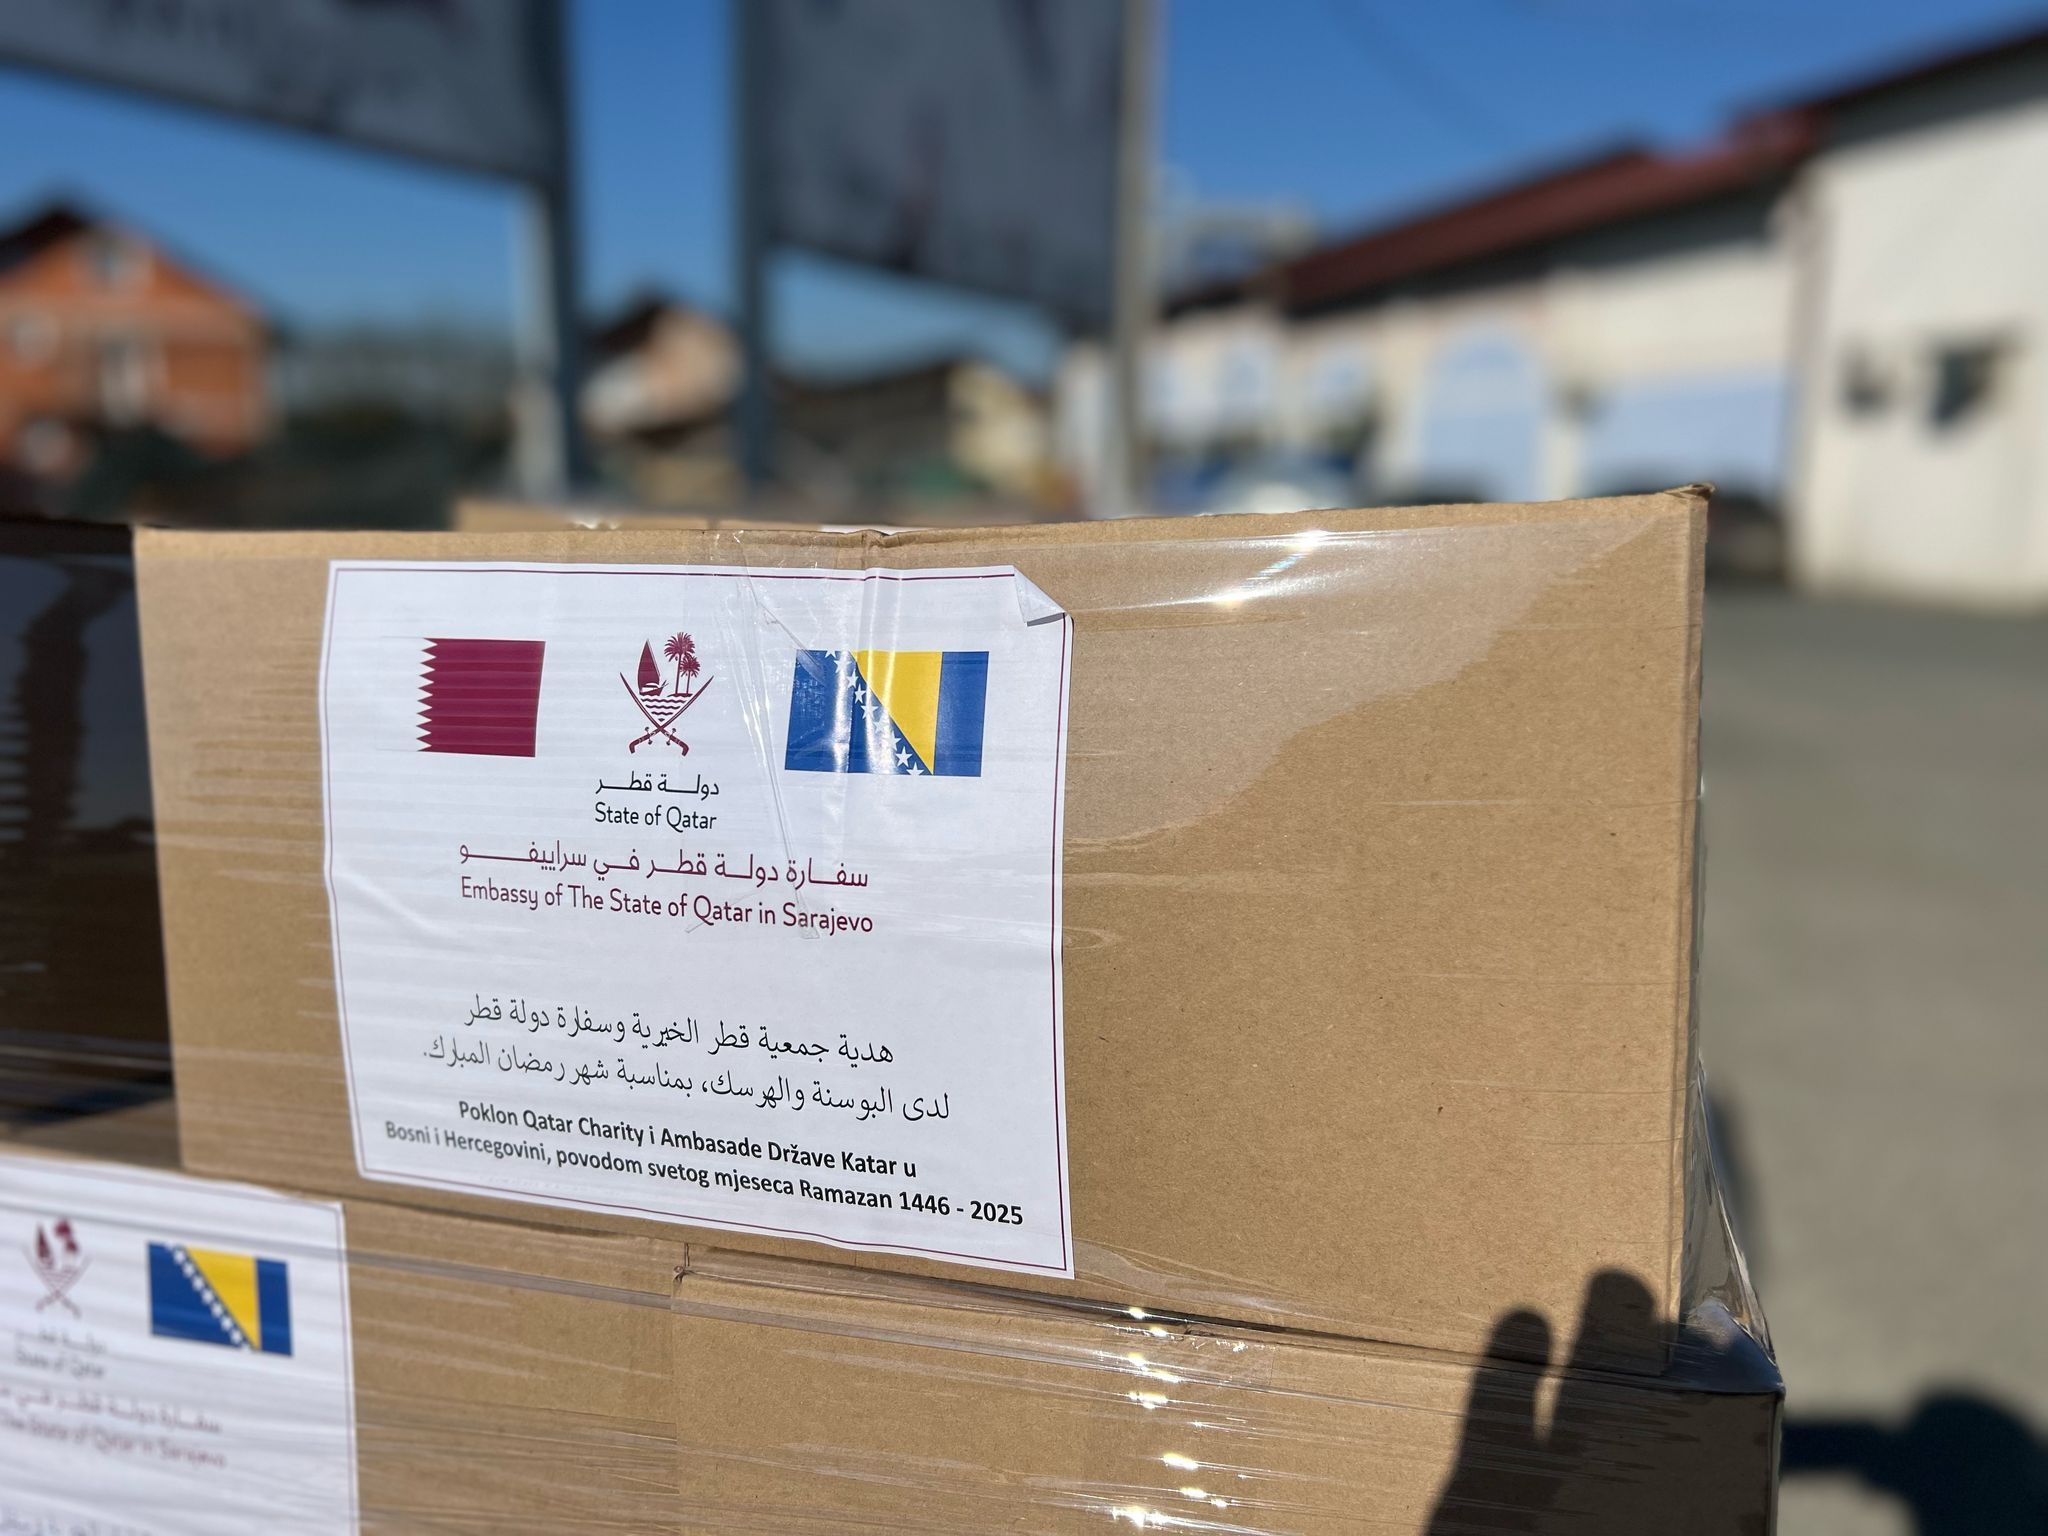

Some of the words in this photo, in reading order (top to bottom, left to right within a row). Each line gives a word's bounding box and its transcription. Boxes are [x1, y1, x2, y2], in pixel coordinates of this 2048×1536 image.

[595, 770, 652, 795] قطر
[657, 773, 720, 800] دولة
[594, 802, 639, 826] State
[644, 803, 661, 827] of
[666, 807, 717, 834] Qatar
[459, 839, 587, 872] سراييفو
[593, 848, 640, 882] في
[645, 848, 706, 879] قطر
[714, 853, 779, 888] دولة
[785, 854, 869, 889] سفارة
[461, 875, 538, 910] Embassy
[544, 884, 563, 907] of
[568, 884, 604, 911] The
[609, 888, 662, 916] State
[667, 893, 688, 917] of
[693, 895, 753, 927] Qatar
[759, 900, 776, 925] in
[782, 902, 873, 936] Sarajevo
[463, 992, 502, 1027] قطر
[509, 998, 550, 1033] دولة
[556, 1005, 626, 1043] وسفارة
[631, 1011, 700, 1050] الخيرية
[707, 1020, 750, 1056] قطر
[758, 1025, 830, 1064] جمعية
[497, 1044, 566, 1082] رمضان
[837, 1033, 894, 1069] هدية
[568, 1058, 609, 1086] شهر
[616, 1057, 694, 1098] بمناسبة
[811, 1079, 893, 1122] البوسنة
[902, 1092, 951, 1122] لدى
[458, 1099, 519, 1127] Poklon
[523, 1108, 573, 1134] Qatar
[578, 1116, 644, 1147] Charity
[649, 1124, 656, 1145] i
[660, 1127, 762, 1159] Ambasade
[767, 1141, 836, 1169] Države
[841, 1151, 898, 1177] Katar
[904, 1161, 917, 1178] u
[385, 1120, 432, 1145] Bosni
[434, 1127, 441, 1146] i
[444, 1128, 552, 1165] Hercegovini,
[556, 1148, 643, 1175] povodom
[647, 1160, 710, 1188] svetog
[714, 1169, 795, 1197] mjeseca
[800, 1179, 893, 1209] Ramazan
[899, 1190, 951, 1216] 1446
[970, 1200, 1024, 1226] 2025
